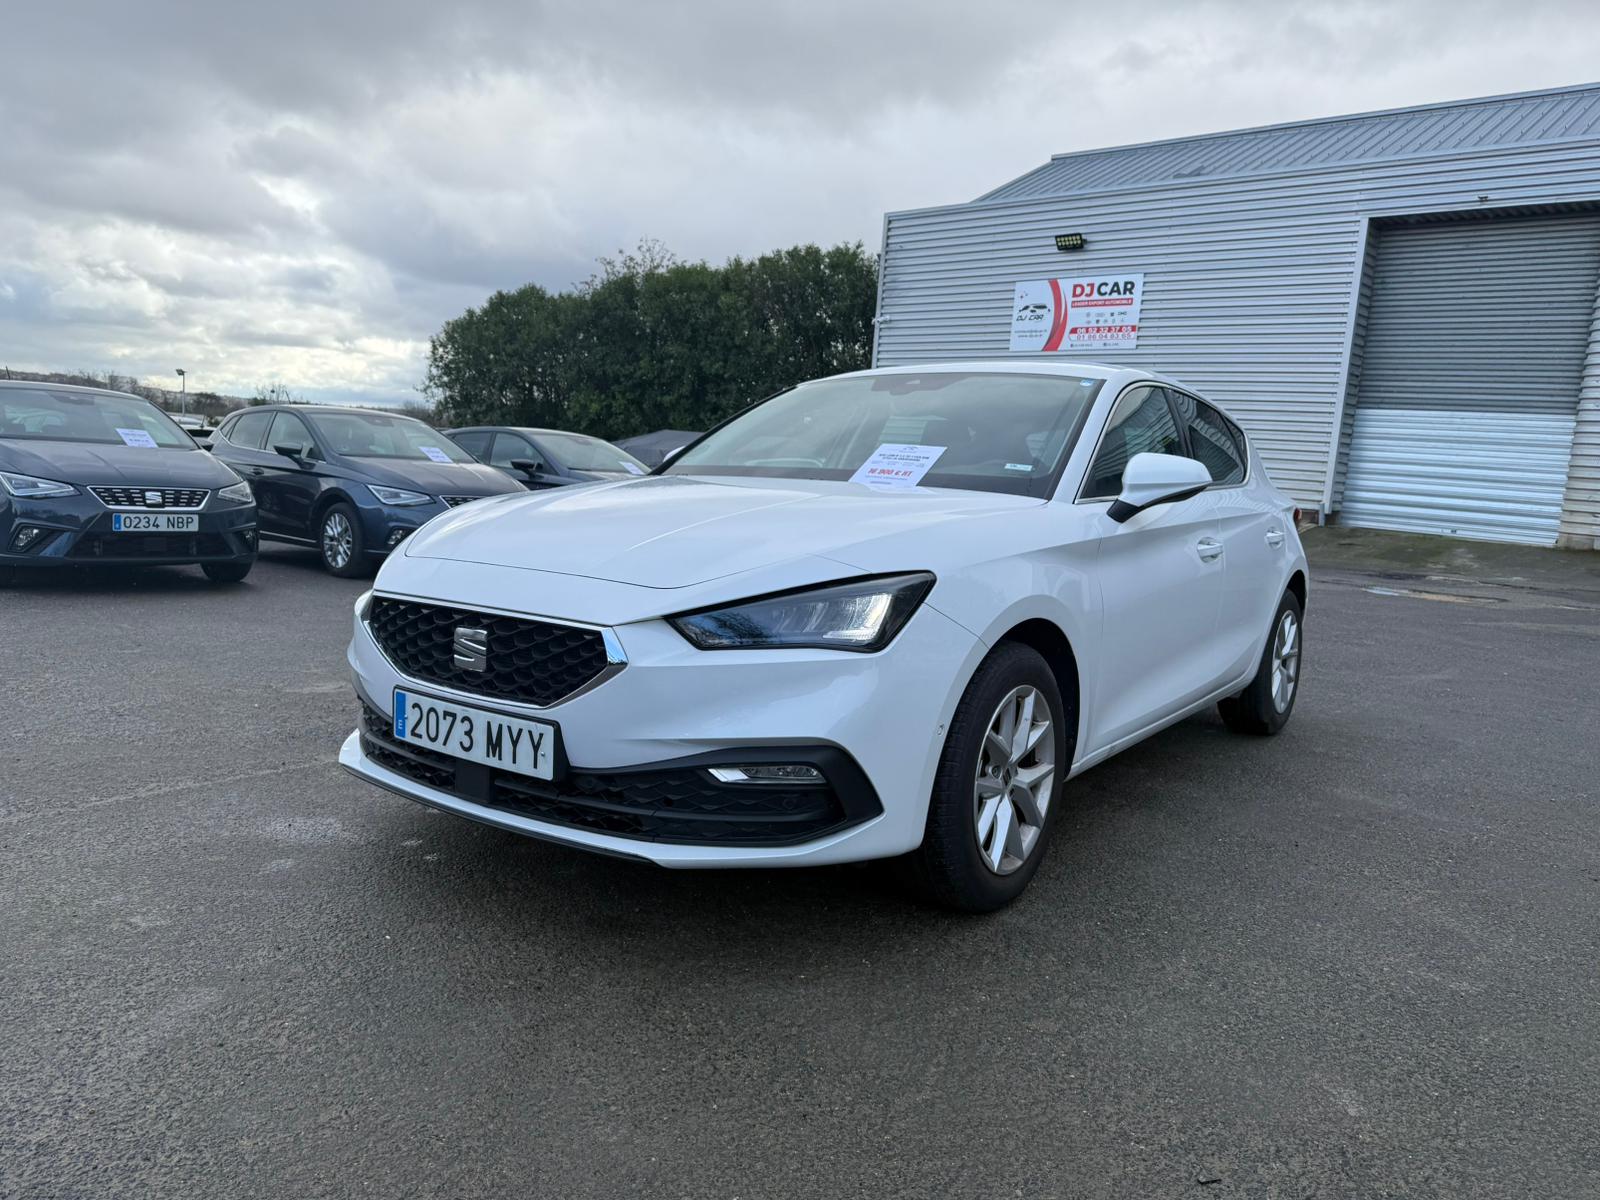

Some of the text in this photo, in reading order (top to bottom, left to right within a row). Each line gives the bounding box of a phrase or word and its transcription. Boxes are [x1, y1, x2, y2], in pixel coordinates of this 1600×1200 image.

[1072, 281, 1135, 298] DJ CAR
[123, 516, 194, 529] 0234 NBP
[410, 702, 544, 769] 2073 MYY
